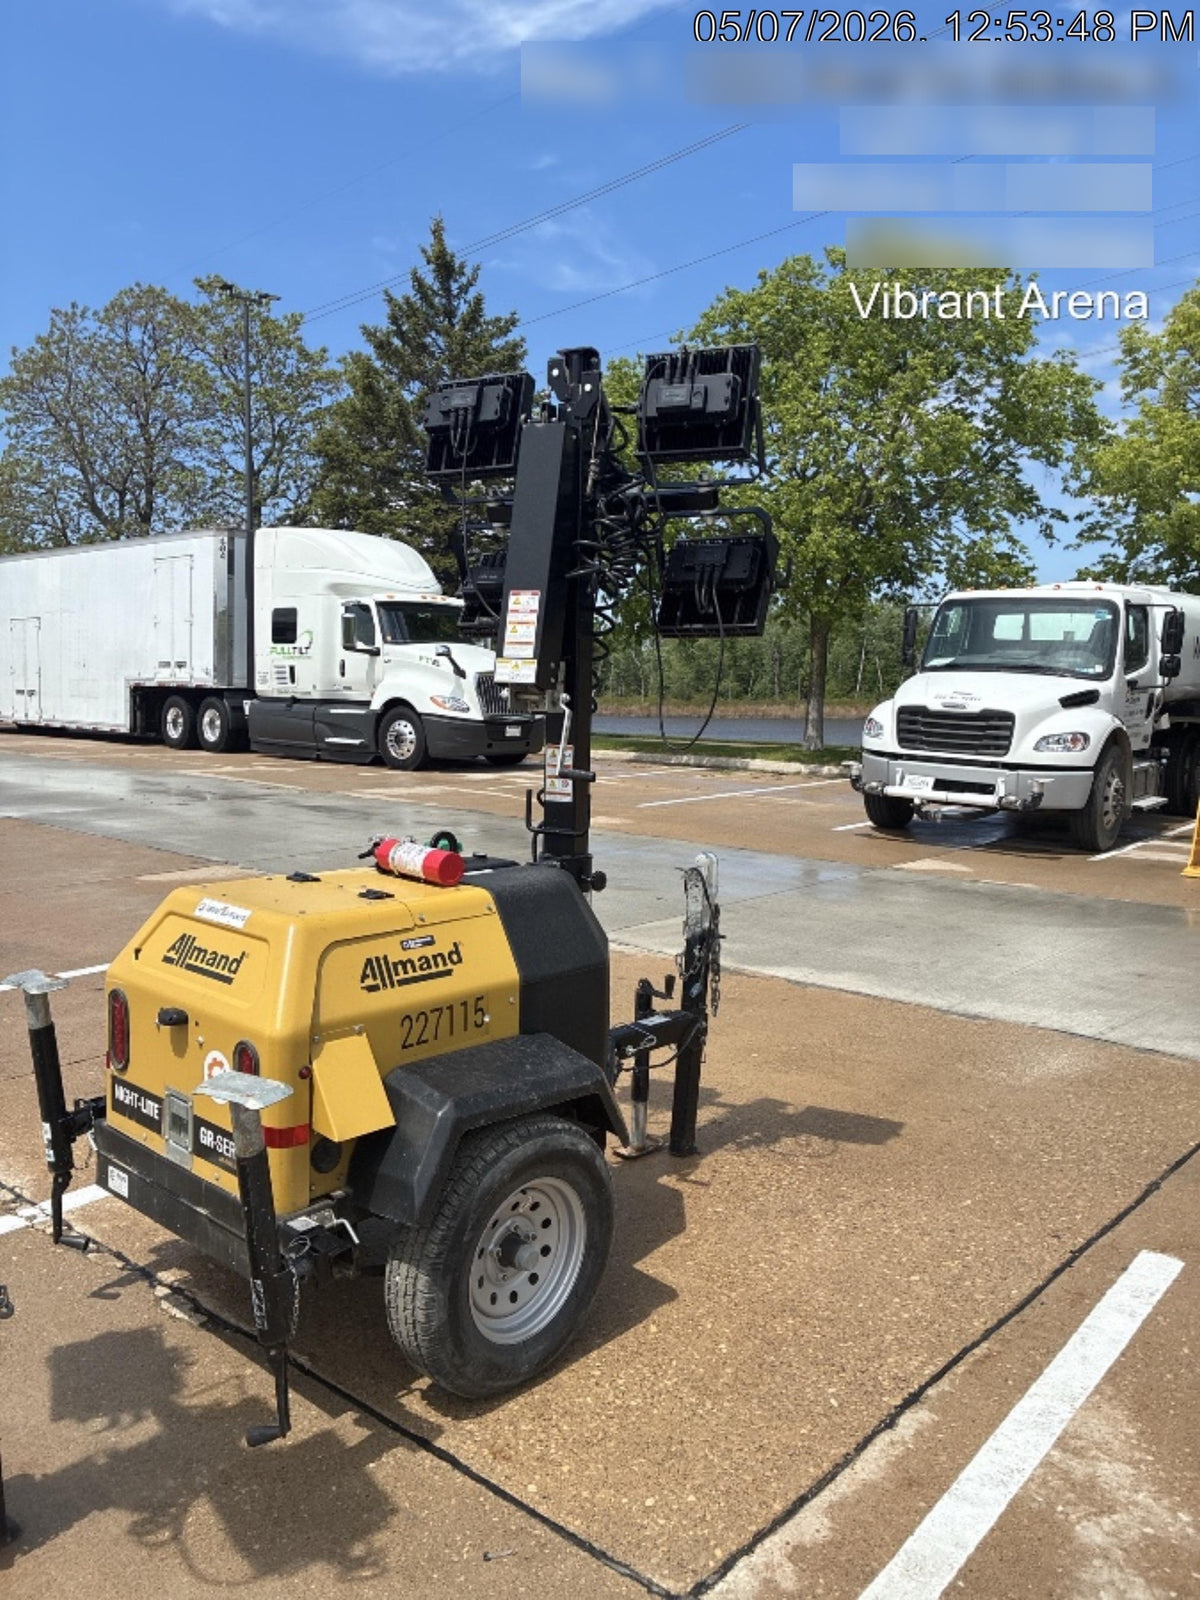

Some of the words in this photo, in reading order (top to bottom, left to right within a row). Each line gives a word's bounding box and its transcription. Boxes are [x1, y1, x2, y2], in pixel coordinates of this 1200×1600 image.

[165, 932, 246, 976] Allmand
[360, 941, 463, 989] Allmand
[400, 995, 485, 1050] 227115
[199, 1126, 237, 1158] GR-SER
